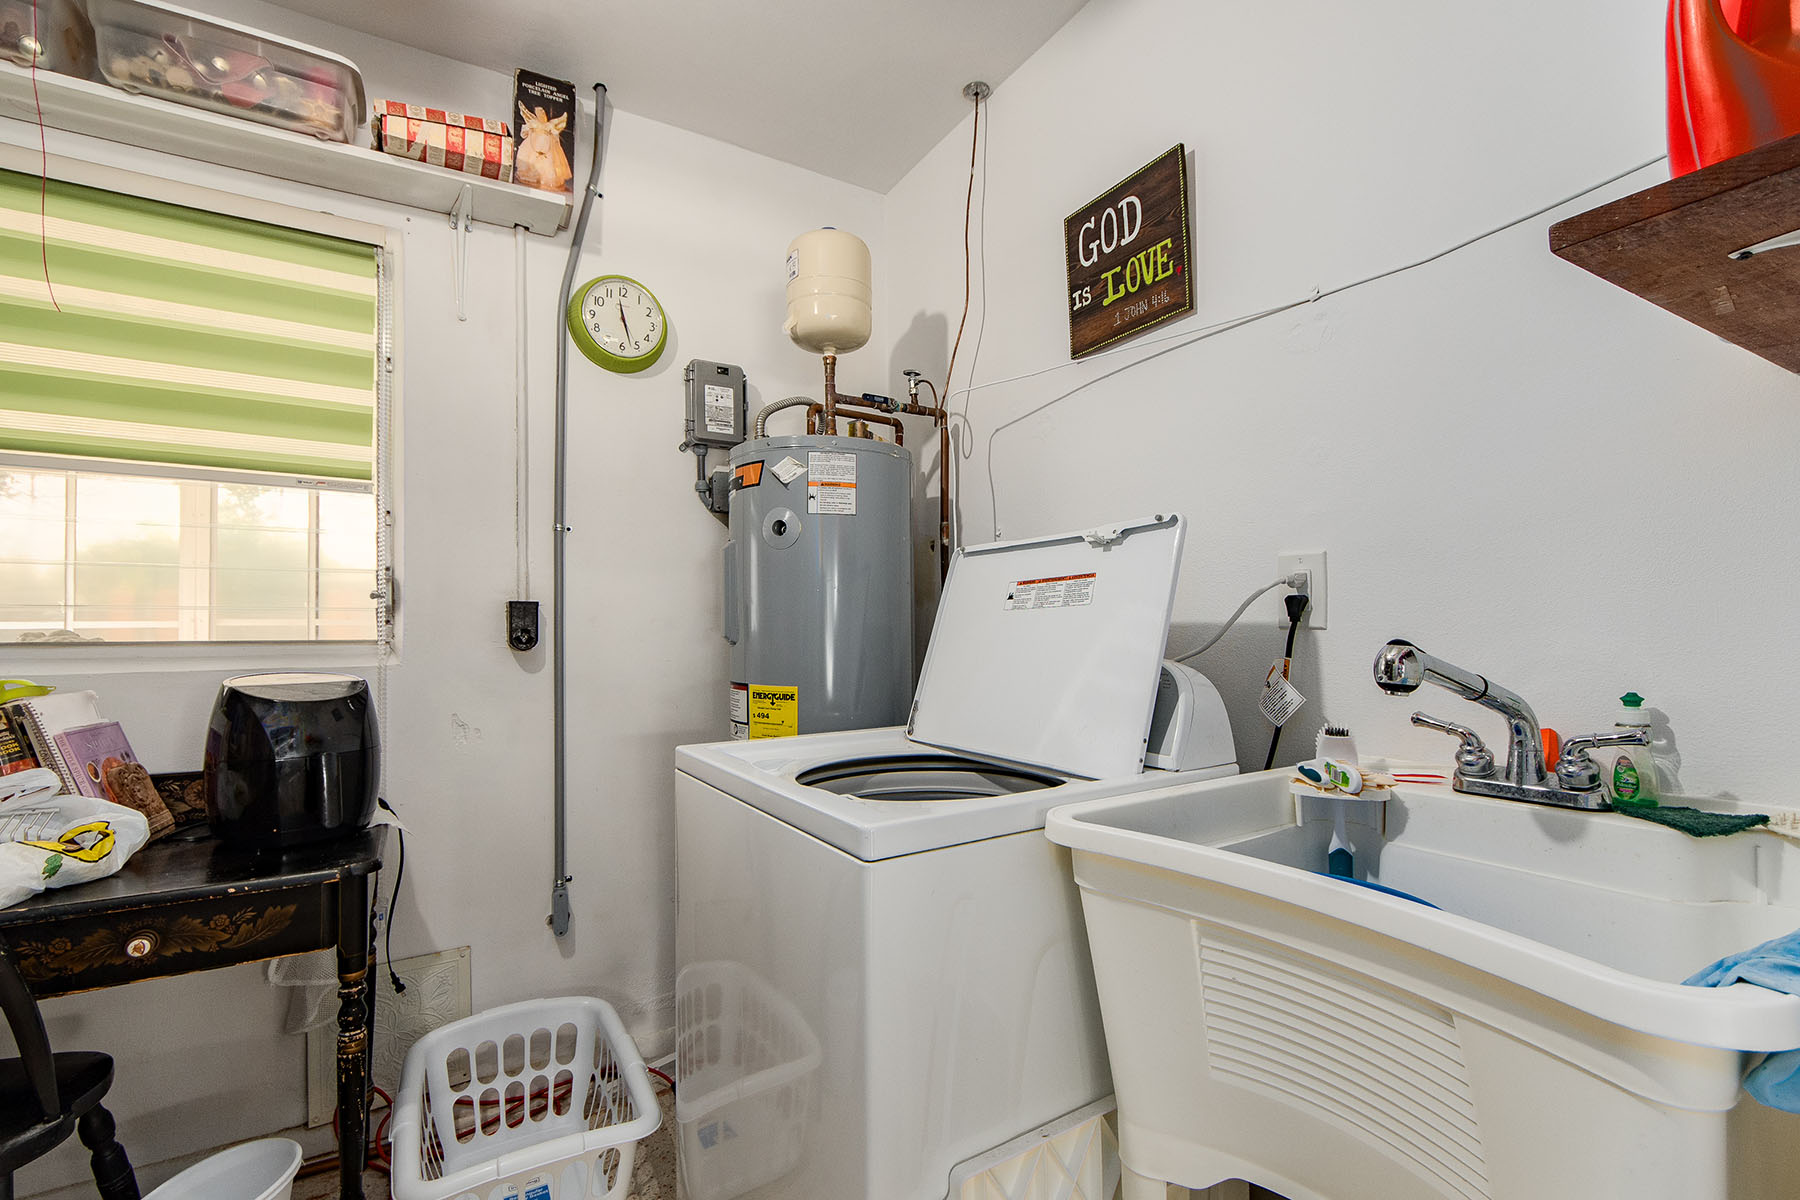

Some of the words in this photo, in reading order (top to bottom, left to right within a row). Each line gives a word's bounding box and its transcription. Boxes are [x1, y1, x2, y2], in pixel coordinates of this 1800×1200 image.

[1078, 195, 1143, 268] GOD
[606, 287, 613, 299] 11
[618, 286, 628, 298] 12
[1072, 285, 1092, 310] IS
[594, 295, 605, 307] 10
[588, 309, 596, 319] 9
[645, 306, 652, 318] 2
[1123, 299, 1149, 321] JOHN
[593, 322, 600, 333] 8
[649, 321, 656, 332] 3
[643, 333, 650, 343] 4
[619, 341, 626, 351] 6
[633, 340, 640, 350] 5
